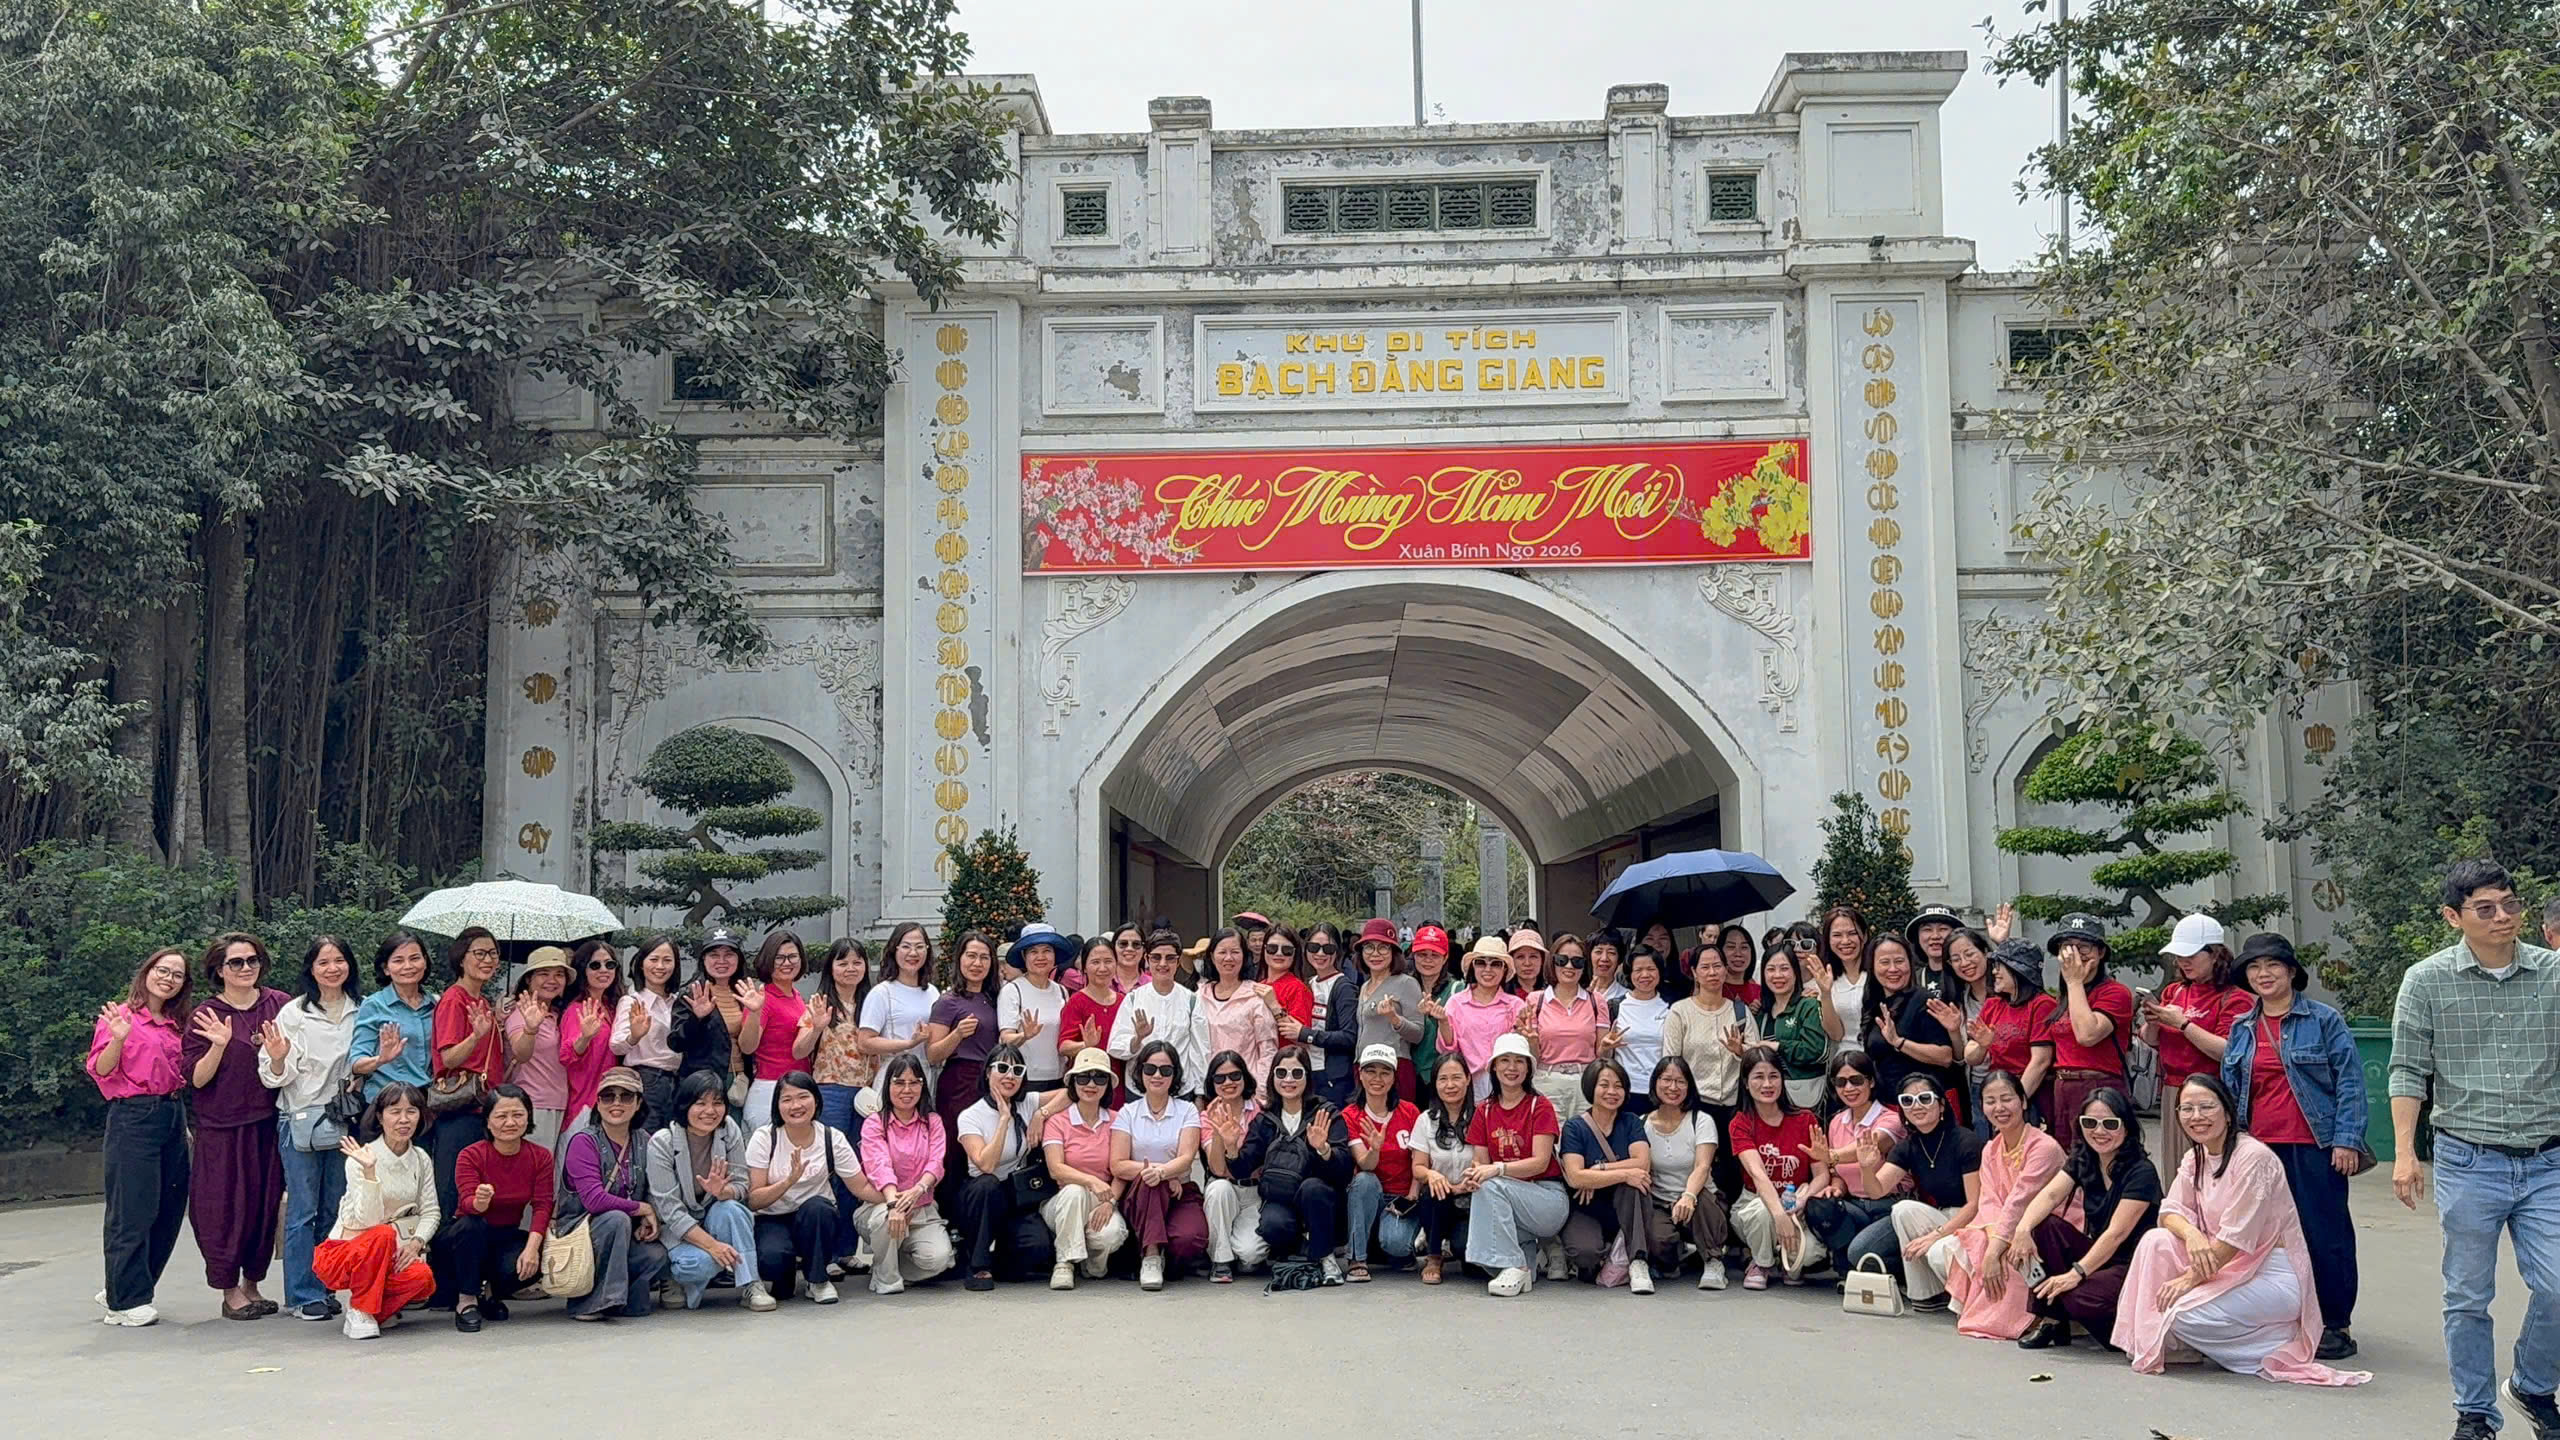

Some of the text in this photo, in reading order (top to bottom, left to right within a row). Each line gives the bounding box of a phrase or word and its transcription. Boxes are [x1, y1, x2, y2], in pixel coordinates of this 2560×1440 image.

[1286, 325, 1537, 352] KHU DI TÍCH
[1217, 354, 1605, 399] BẠCH ĐẰNG GIANG
[1155, 463, 1685, 552] Chúc Mừng Năm Mới
[1399, 541, 1582, 562] Xuân Bính Ngọ 2026
